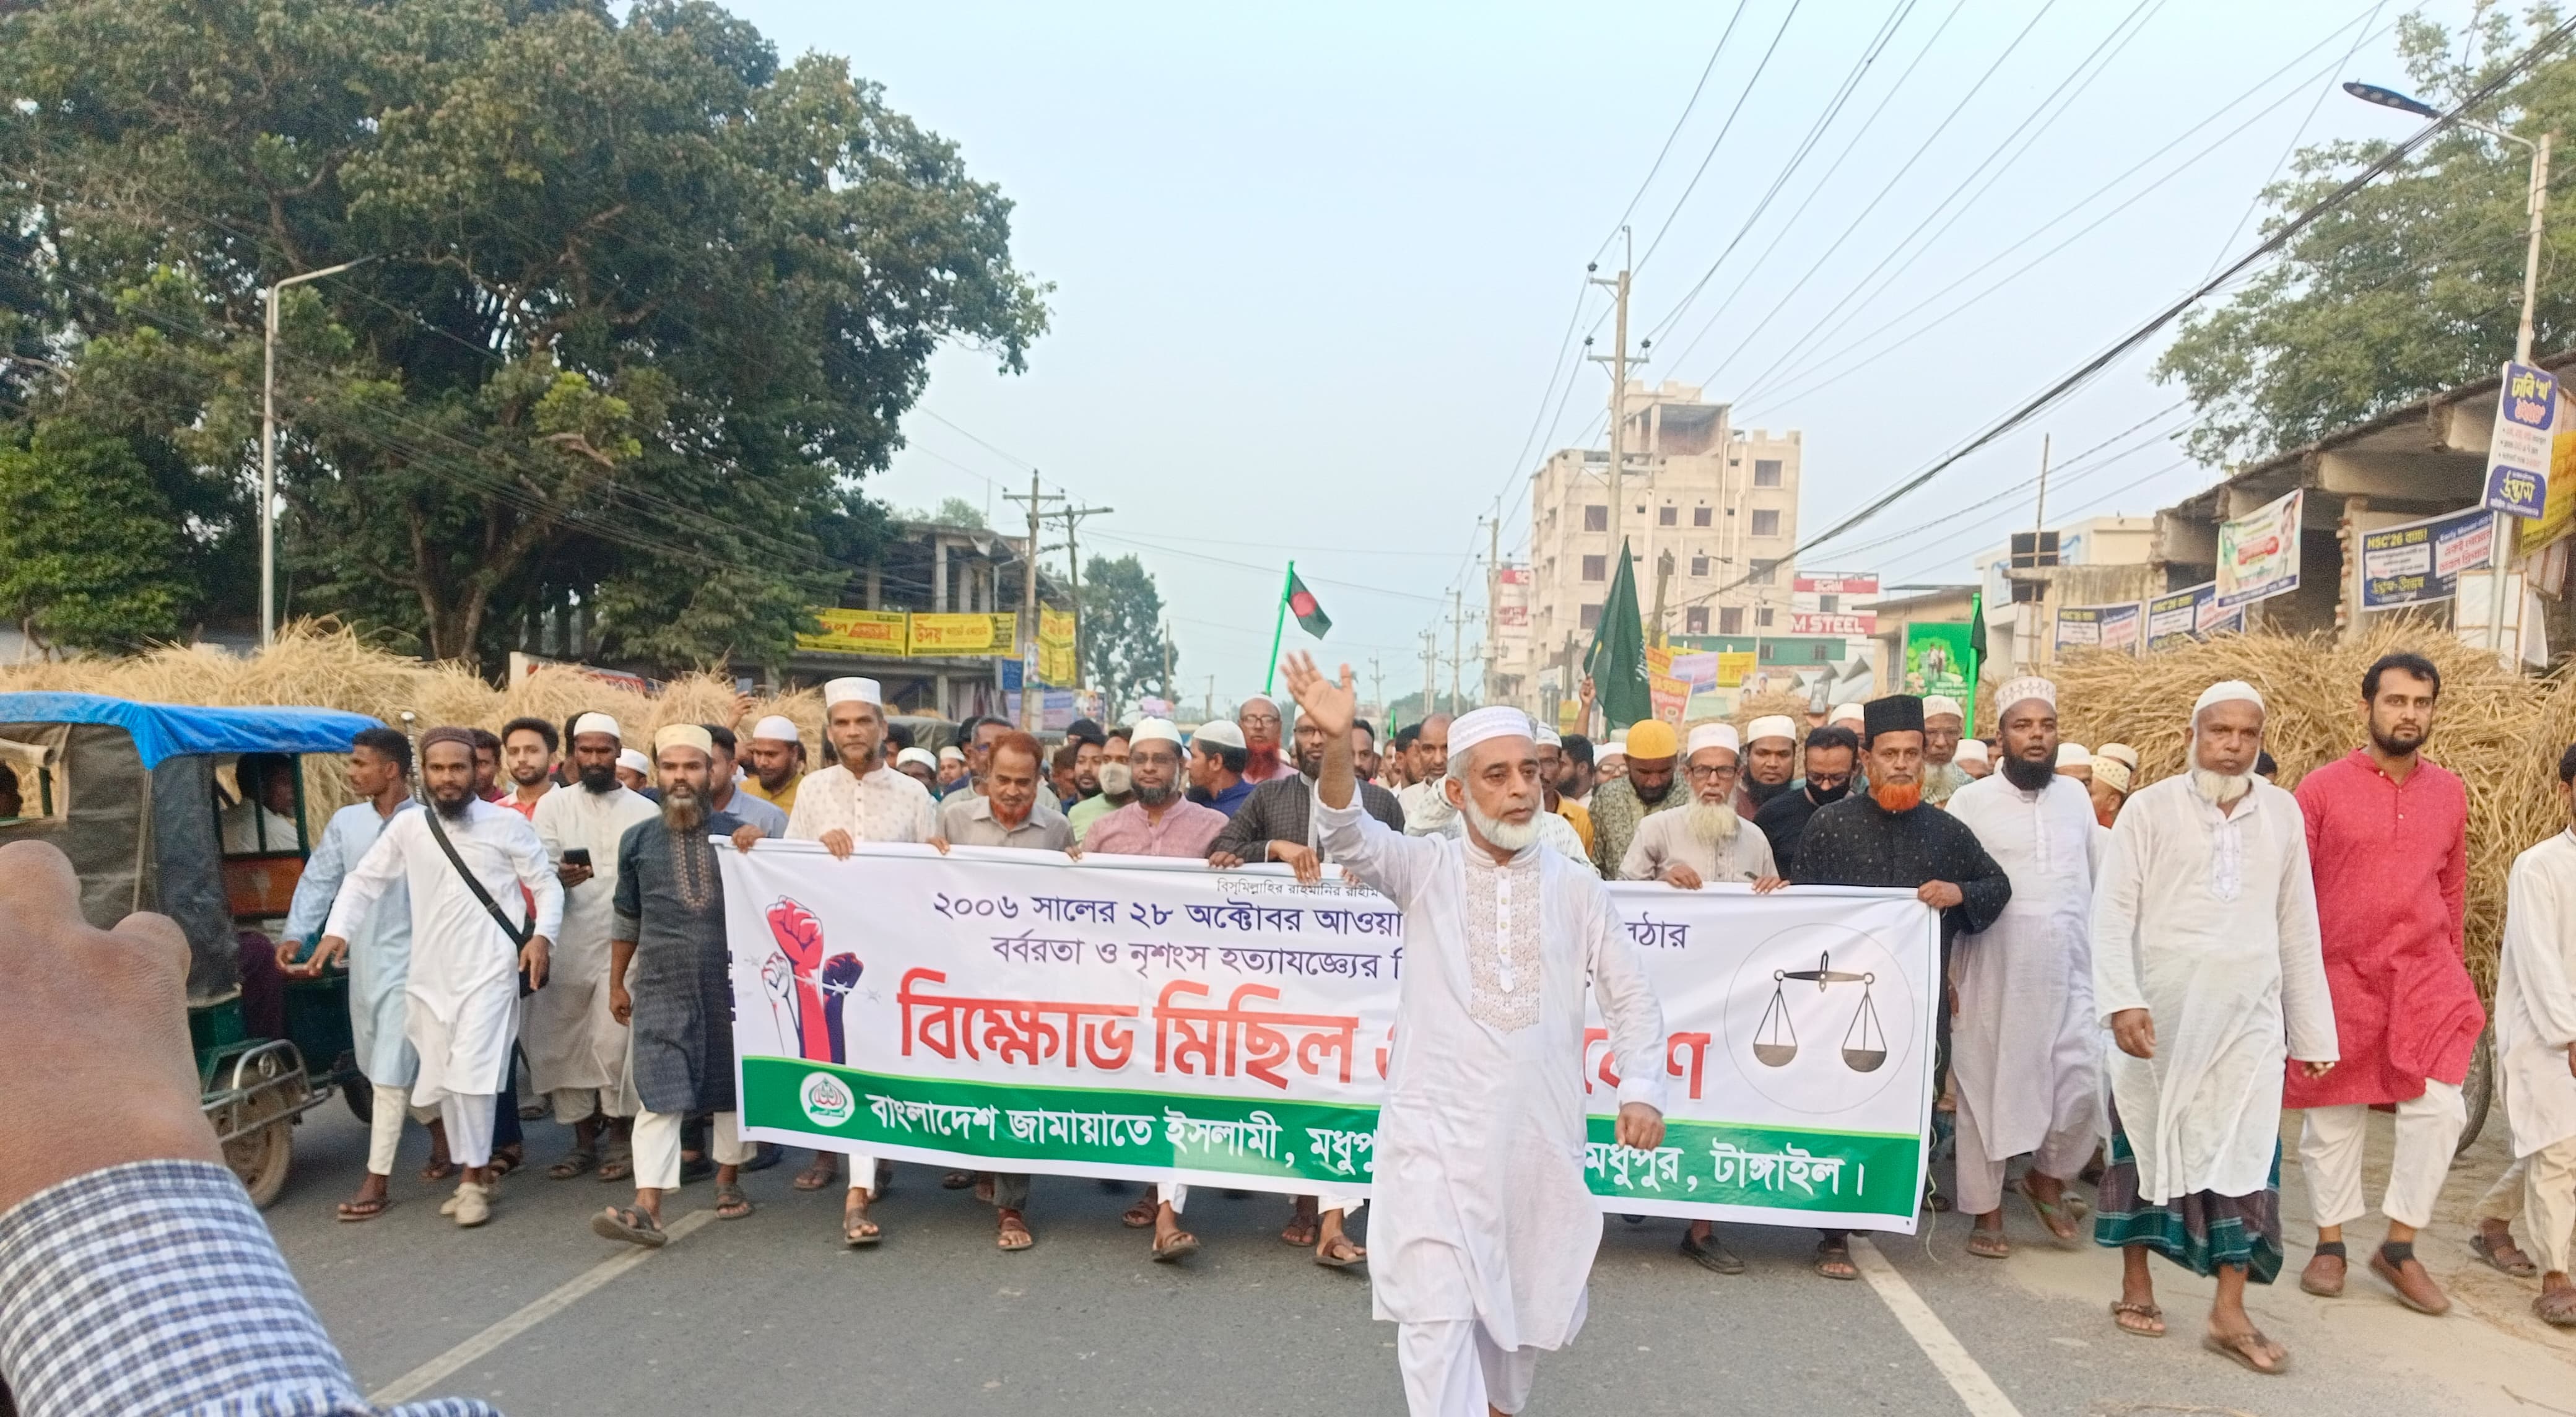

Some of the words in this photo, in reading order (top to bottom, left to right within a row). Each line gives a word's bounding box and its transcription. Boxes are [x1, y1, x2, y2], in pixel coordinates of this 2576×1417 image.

[1791, 615, 1806, 632] M
[1809, 615, 1865, 632] STEEL
[934, 892, 1019, 920] ২০০৬
[1030, 896, 1117, 924] সালের
[1129, 902, 1173, 929] ২৮
[1184, 898, 1304, 932] অক্টোবর
[1312, 908, 1403, 937] আওয়া
[991, 928, 1084, 964] বর্বরতা
[1095, 943, 1117, 964] ও
[1128, 941, 1211, 978] নৃশংস
[897, 967, 1139, 1070] বিক্ষোভ
[1152, 980, 1359, 1090] মিছিল
[865, 1092, 1000, 1141] বাংলাদেশ
[1005, 1107, 1156, 1147] জামায়াতে
[1305, 1128, 1377, 1175] মধুপু
